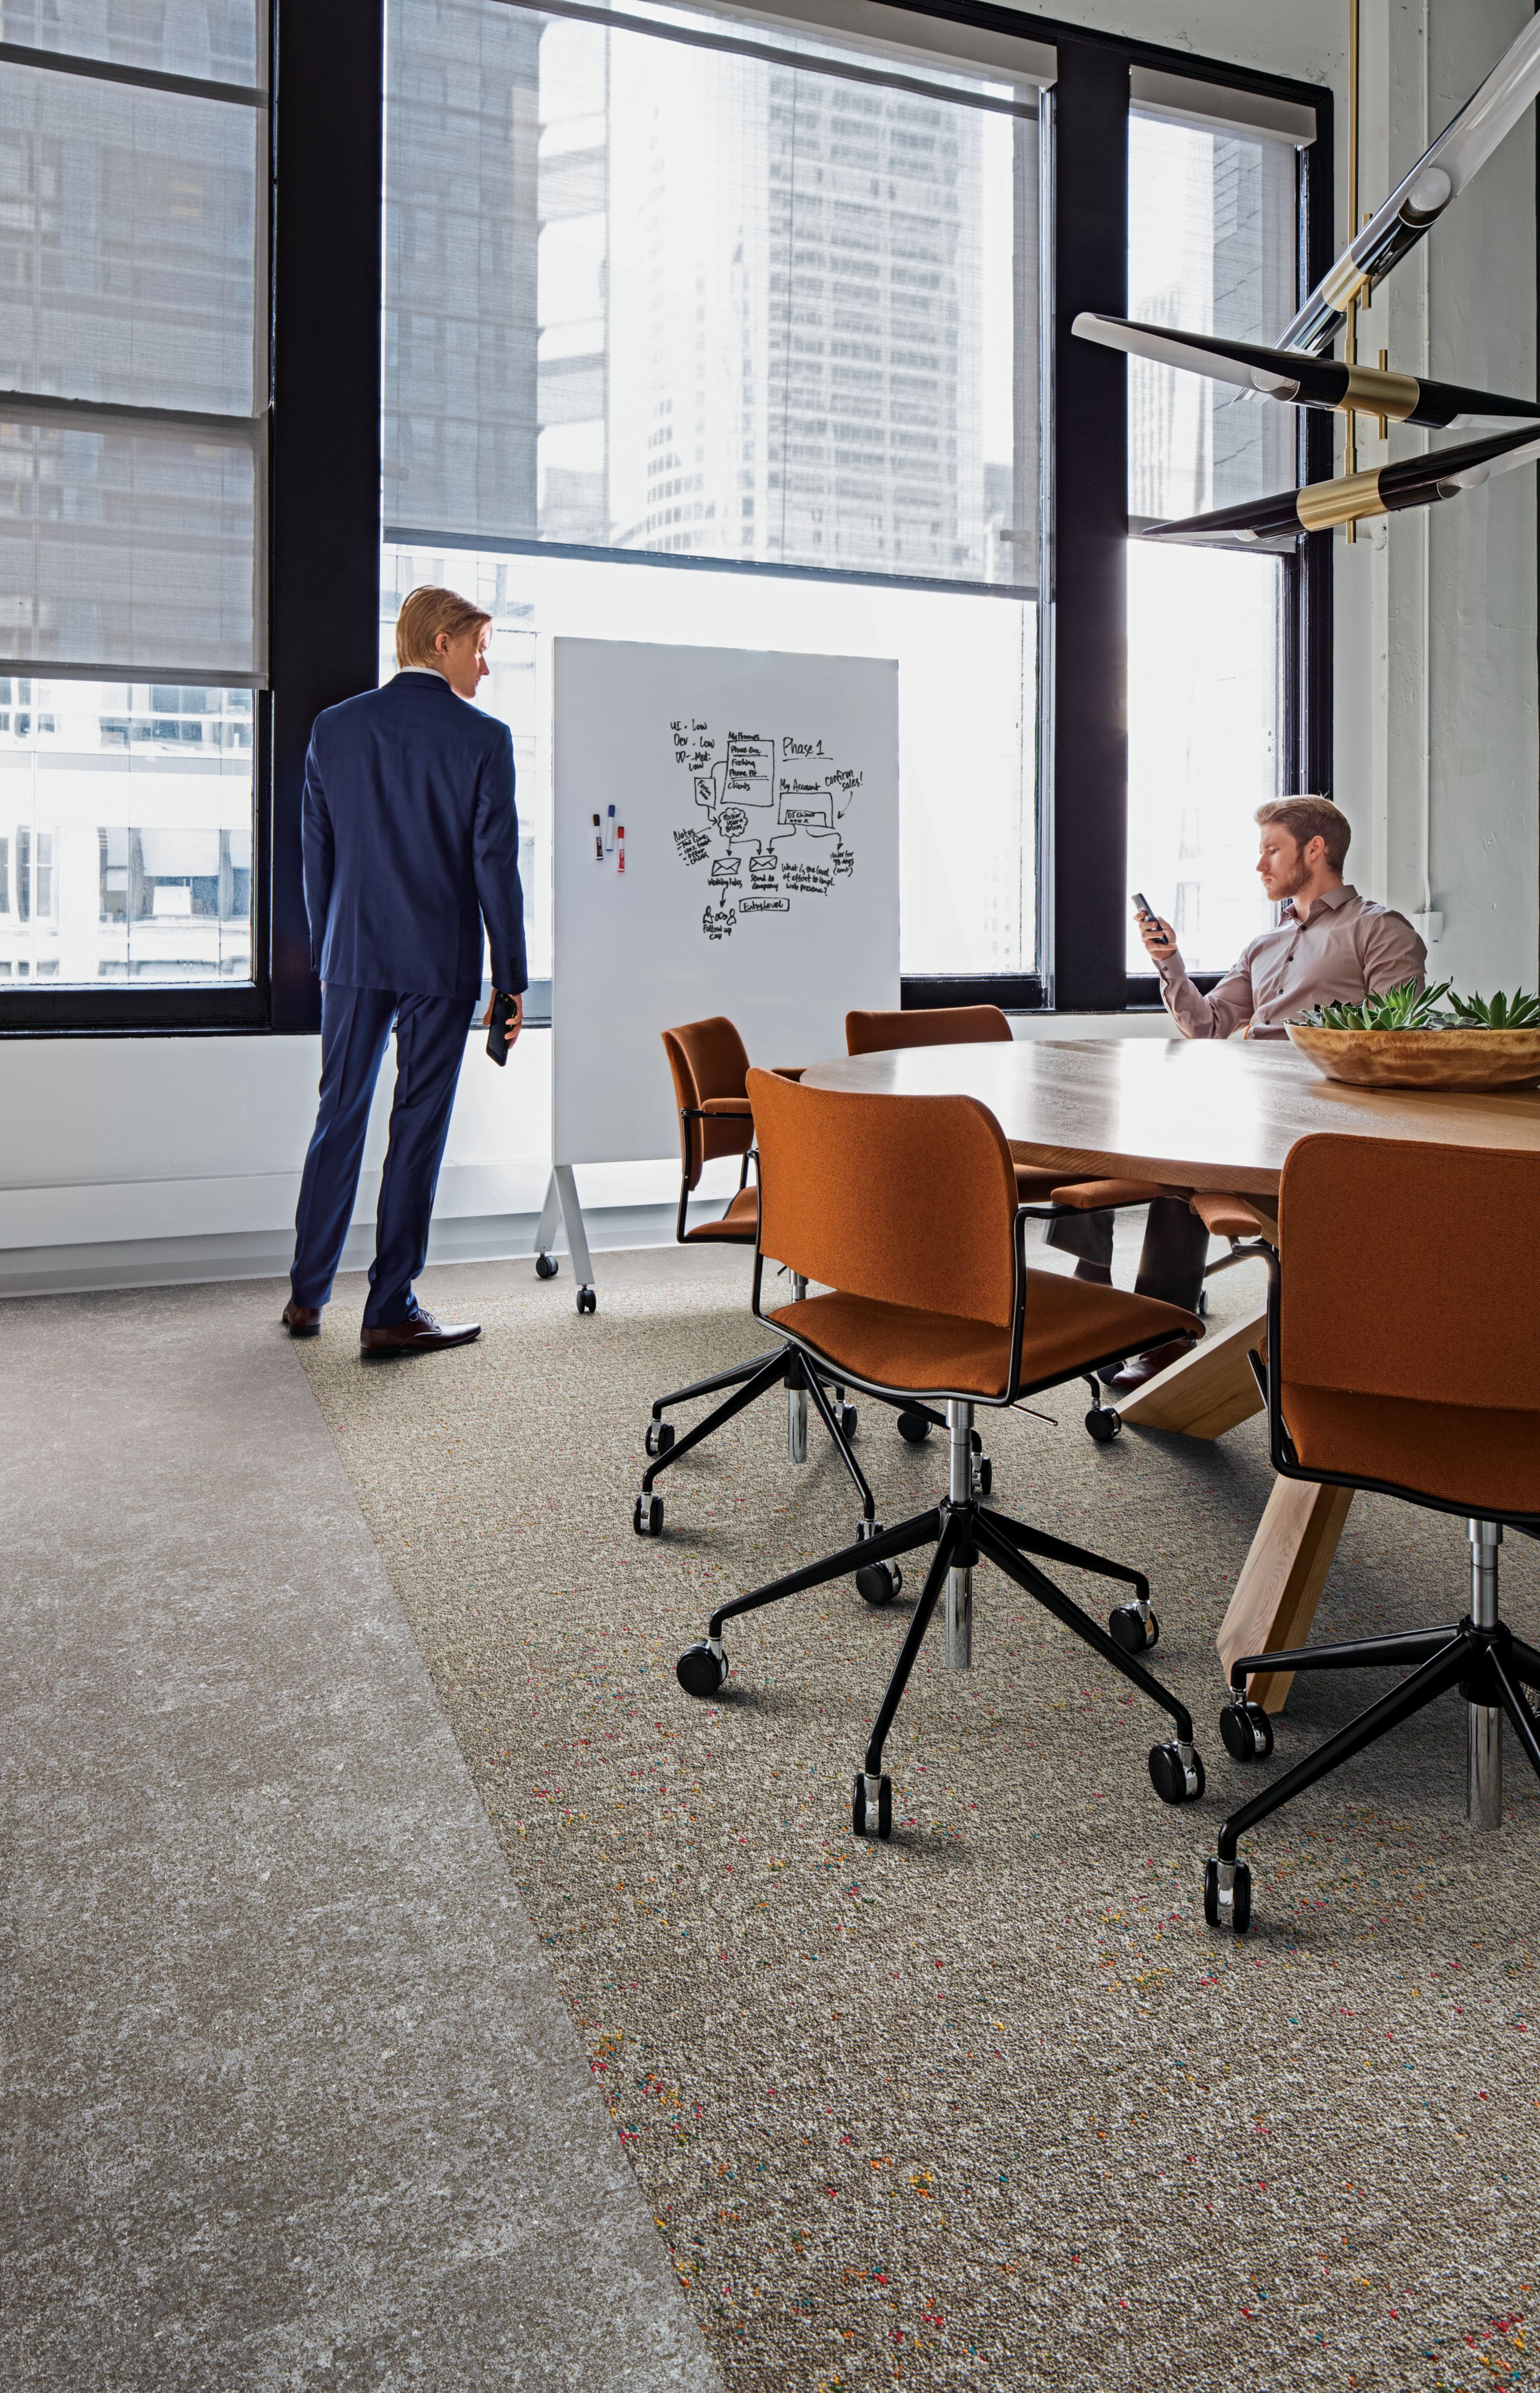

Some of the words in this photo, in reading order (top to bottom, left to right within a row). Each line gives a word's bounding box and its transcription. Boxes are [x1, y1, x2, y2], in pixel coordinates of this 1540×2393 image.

[692, 719, 707, 731] Low
[674, 733, 688, 746] Dev
[700, 736, 715, 748] Low
[783, 737, 814, 757] Phase
[816, 739, 824, 755] 1
[689, 761, 703, 771] Low
[780, 779, 790, 792] My
[793, 779, 821, 792] Account
[673, 828, 695, 843] Notes
[782, 863, 798, 872] What
[816, 865, 830, 877] level
[703, 925, 723, 933] Follow
[724, 927, 732, 936] up
